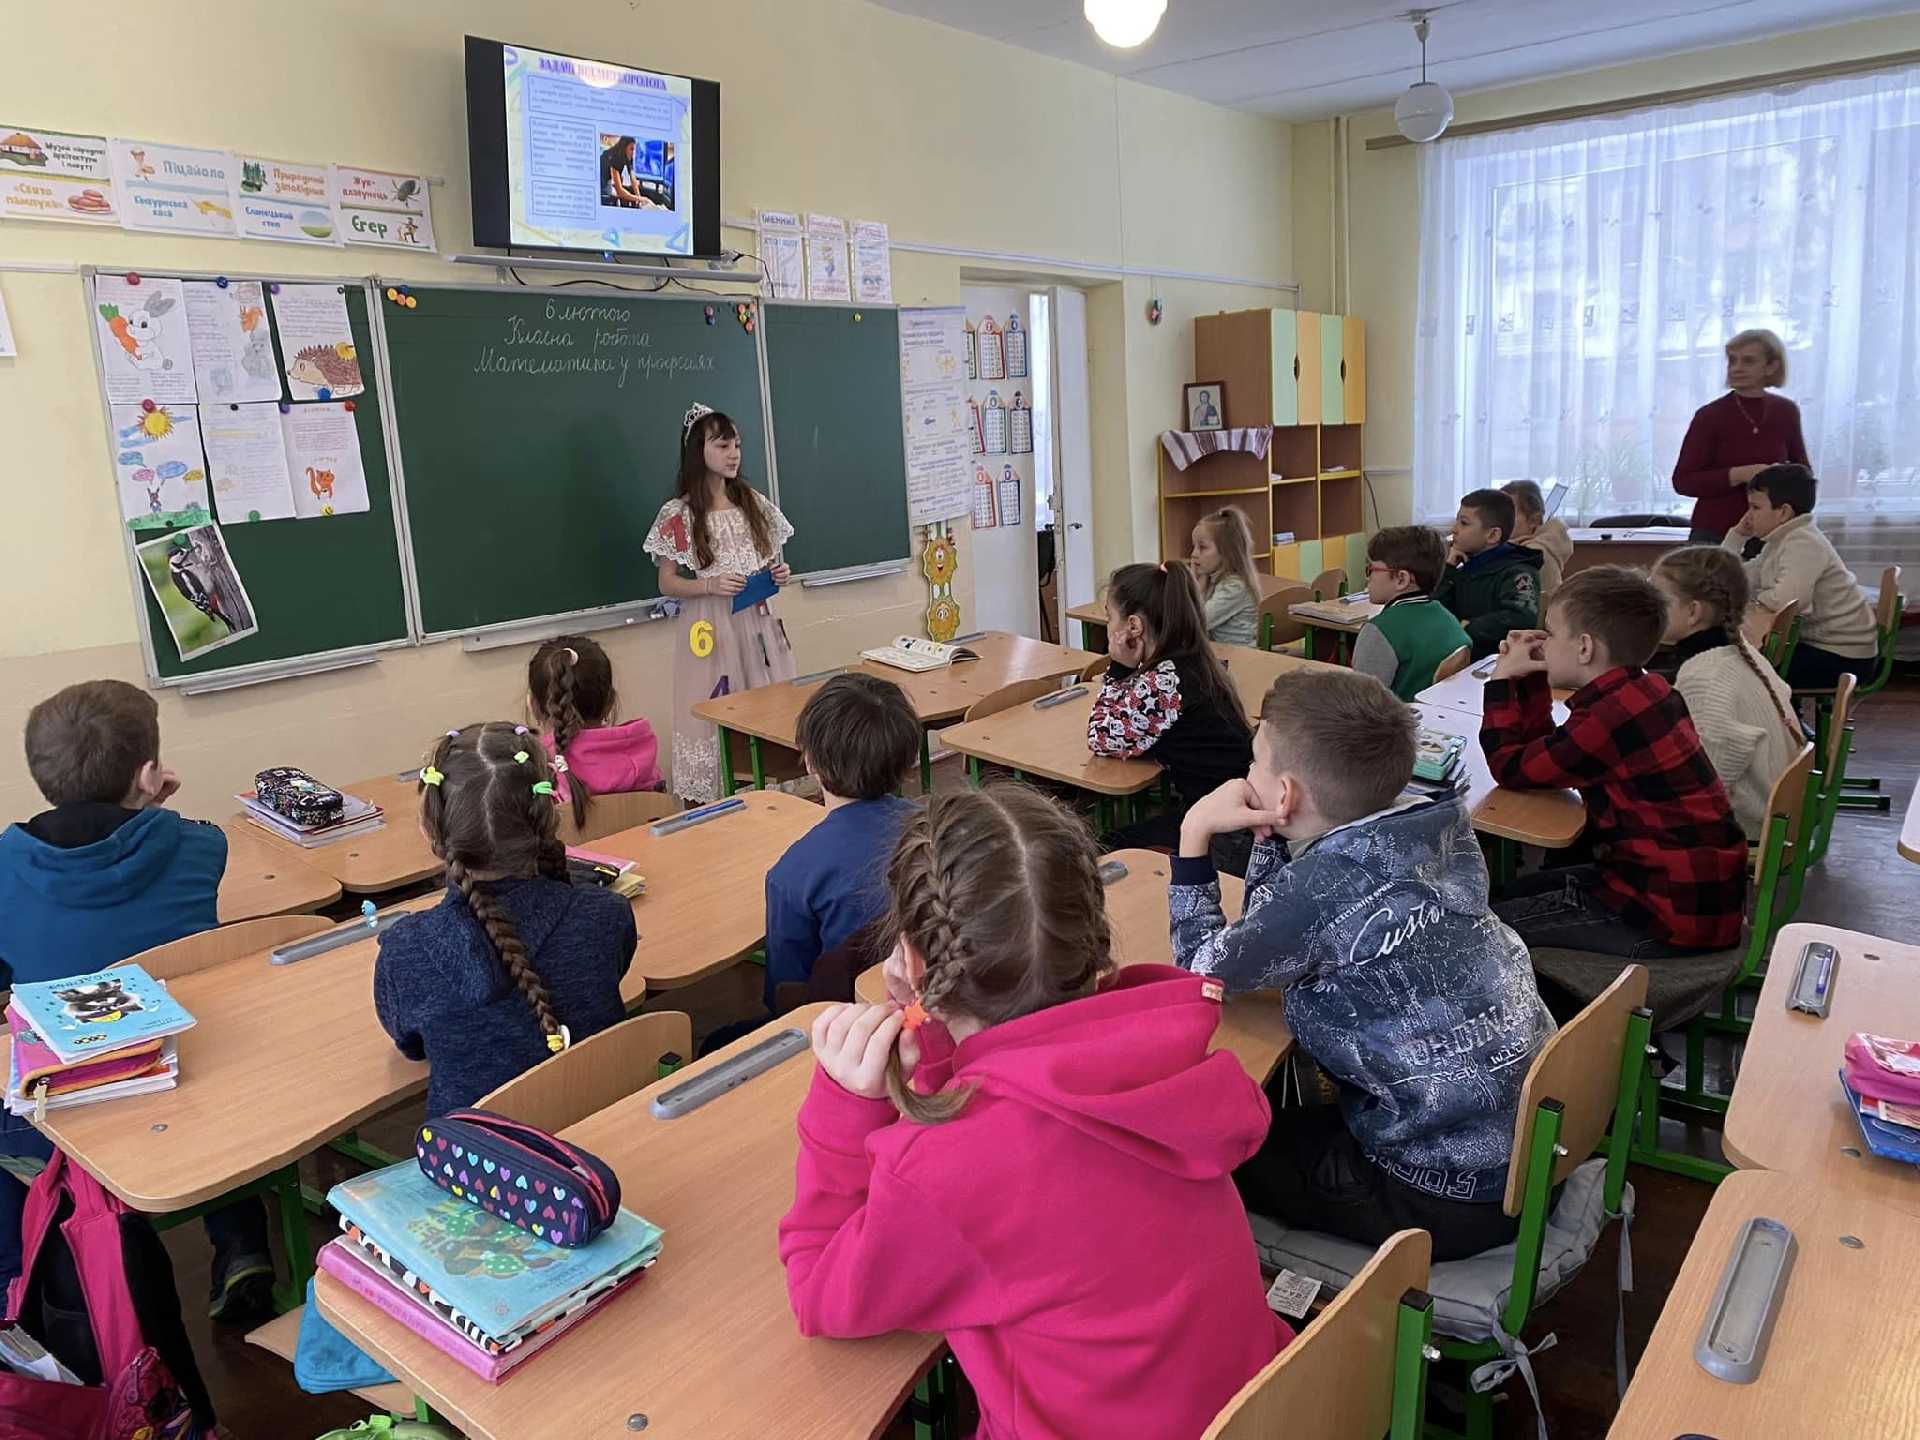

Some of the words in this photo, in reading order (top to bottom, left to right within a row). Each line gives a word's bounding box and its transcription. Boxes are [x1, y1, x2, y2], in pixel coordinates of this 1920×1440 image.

[162, 160, 226, 181] Піцайоло
[272, 167, 325, 187] Природний
[545, 298, 555, 320] 6
[558, 306, 631, 321] лютого
[503, 316, 574, 346] Класна
[593, 328, 652, 352] робота
[473, 349, 617, 375] Математика
[617, 355, 629, 389] у
[689, 620, 714, 657] 6
